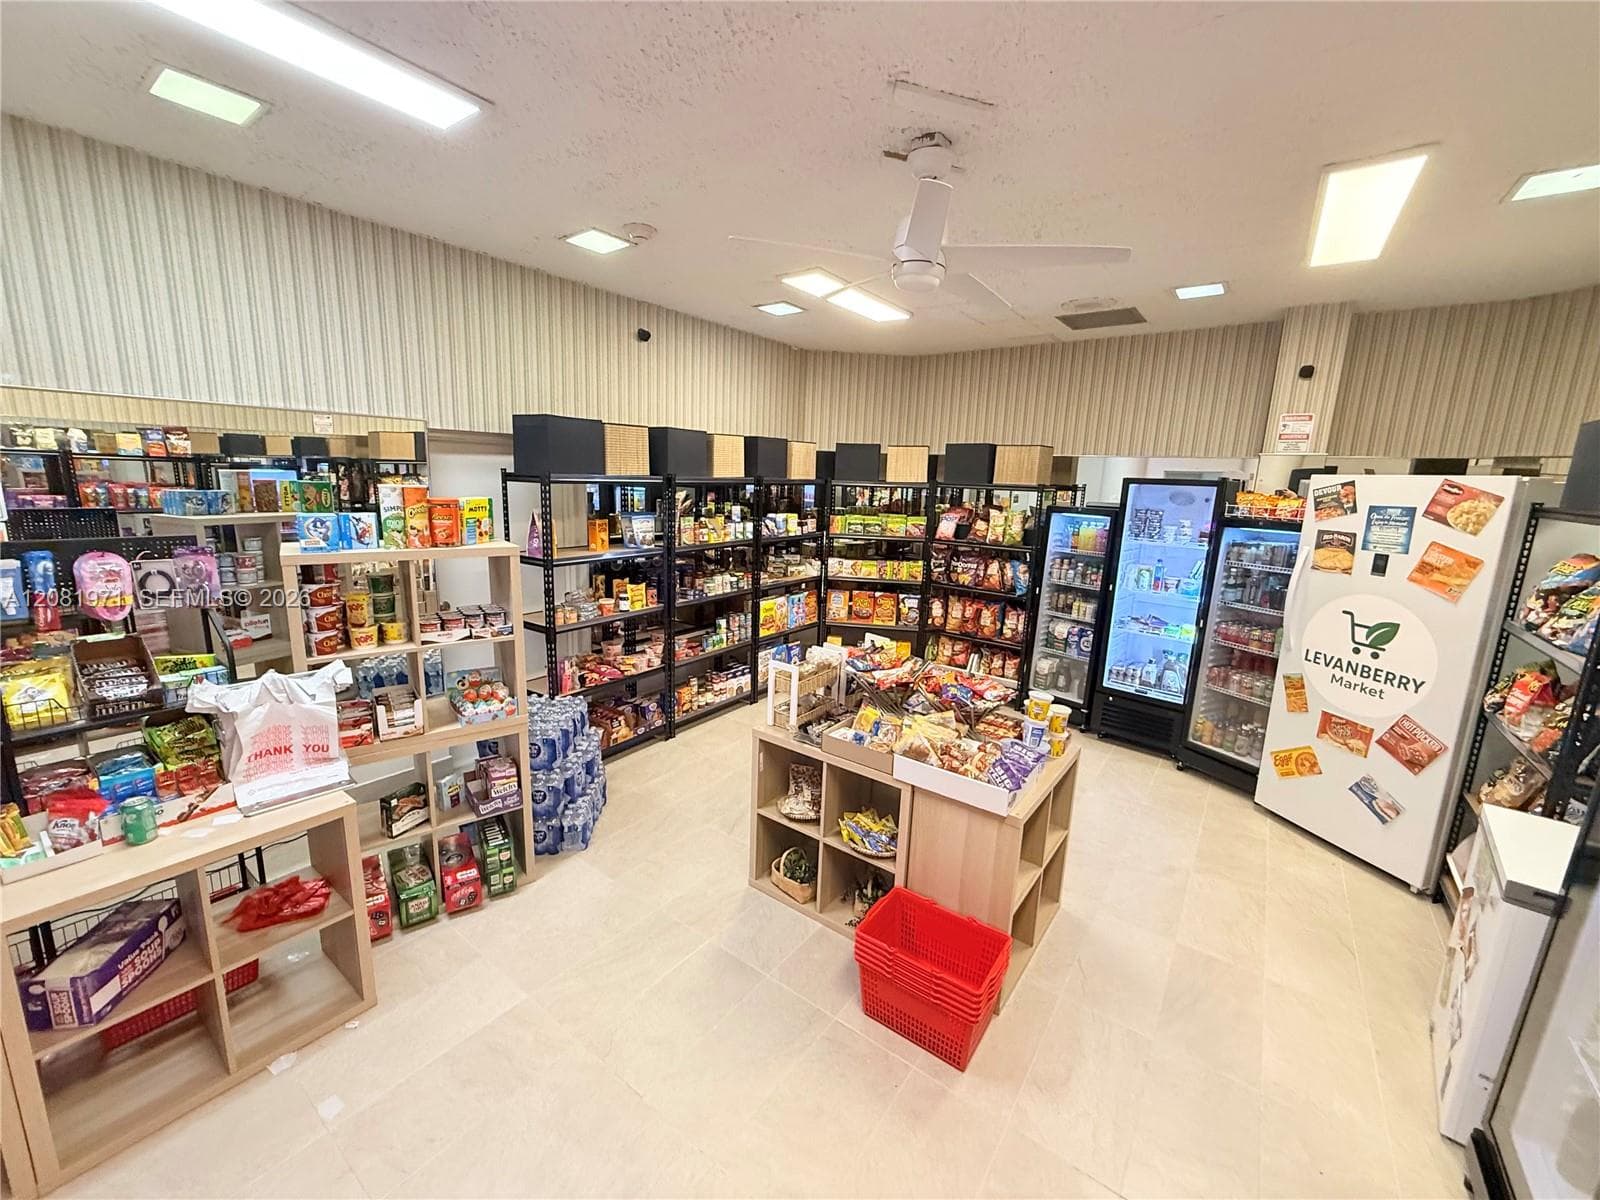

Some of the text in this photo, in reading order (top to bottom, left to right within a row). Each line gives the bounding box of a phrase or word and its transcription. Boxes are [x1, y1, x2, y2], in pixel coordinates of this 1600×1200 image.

[1314, 484, 1342, 497] DEVOUR
[354, 634, 374, 646] POPS
[1304, 648, 1426, 694] LEVANBERRY
[1330, 673, 1385, 700] Market
[247, 744, 329, 763] THANK YOU
[118, 949, 140, 969] Value
[134, 937, 161, 967] SOUP
[121, 946, 162, 988] SPOONS
